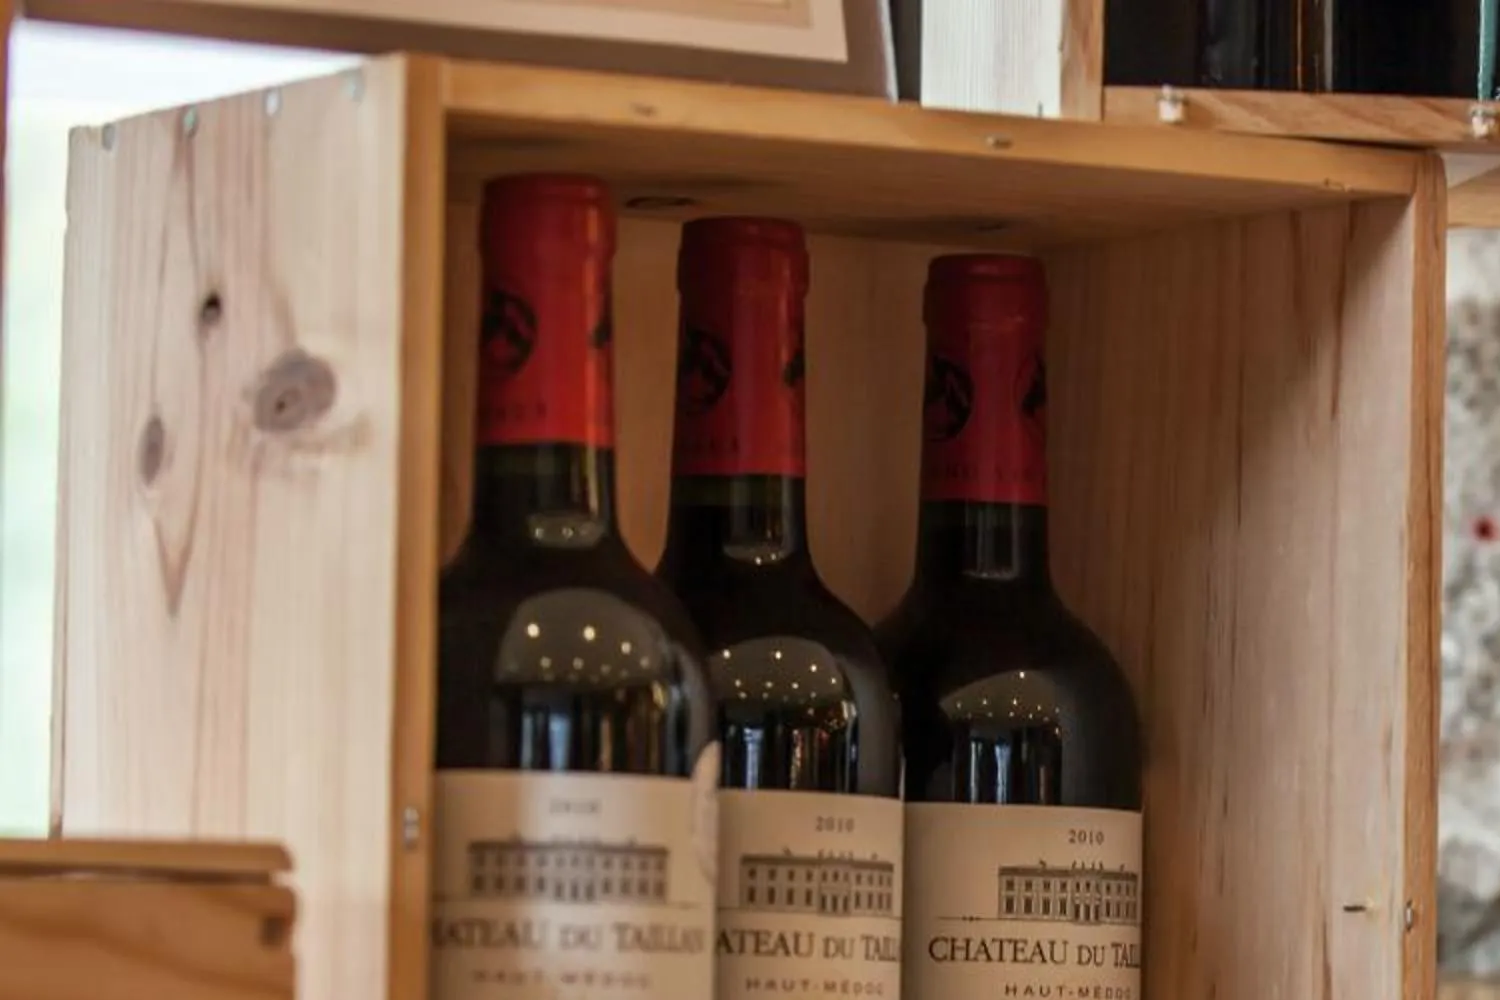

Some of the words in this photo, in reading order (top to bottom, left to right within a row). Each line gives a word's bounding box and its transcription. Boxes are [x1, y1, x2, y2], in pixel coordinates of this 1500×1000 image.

[815, 816, 855, 833] 2010
[1068, 828, 1105, 845] 2010
[716, 928, 816, 959] ATEAU
[822, 936, 856, 960] DU
[928, 936, 1069, 966] CHATEAU
[1076, 945, 1106, 968] DU
